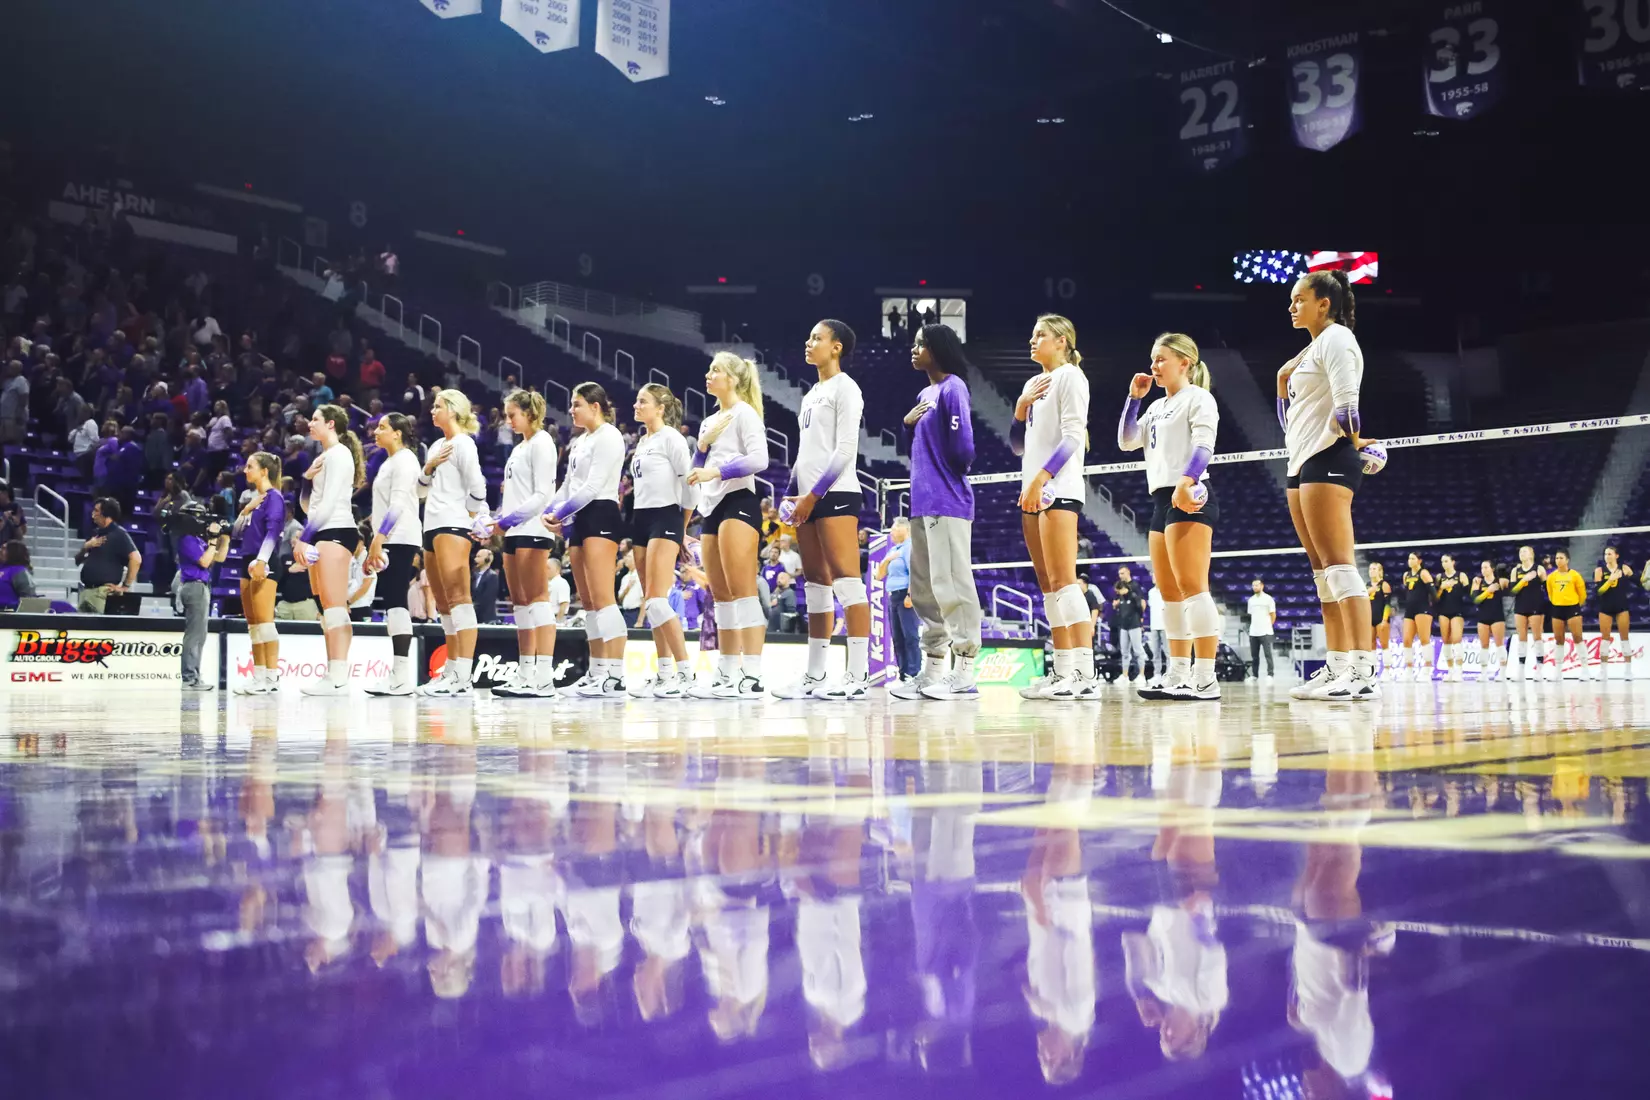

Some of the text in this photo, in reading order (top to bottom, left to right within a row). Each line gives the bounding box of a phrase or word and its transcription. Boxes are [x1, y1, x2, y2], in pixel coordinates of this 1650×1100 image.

[1584, 0, 1650, 53] 30
[1287, 31, 1359, 58] KNOSTMAN
[1429, 18, 1501, 83] 33
[1181, 61, 1236, 84] BARRETT
[1292, 53, 1356, 115] 33
[1441, 82, 1489, 101] 1955-58
[1180, 80, 1241, 140] 22
[62, 181, 156, 215] AHEARN
[349, 200, 368, 229] 8
[578, 252, 592, 276] 9
[807, 272, 825, 296] 9
[1044, 276, 1077, 300] 10
[802, 408, 812, 430] 10
[951, 415, 960, 431] 5
[1513, 425, 1551, 435] K-STATE
[1581, 418, 1620, 428] K-STATE
[1151, 425, 1157, 449] 3
[1386, 437, 1421, 447] K-STATE
[1448, 431, 1484, 440] K-STATE
[633, 459, 642, 478] 12
[1214, 453, 1245, 461] K-STATE
[870, 560, 884, 662] K-STATE
[13, 655, 62, 663] AUTO GROUP
[15, 631, 183, 663] Briggsauto.co
[11, 672, 63, 682] GMC
[473, 654, 520, 683] Pizz
